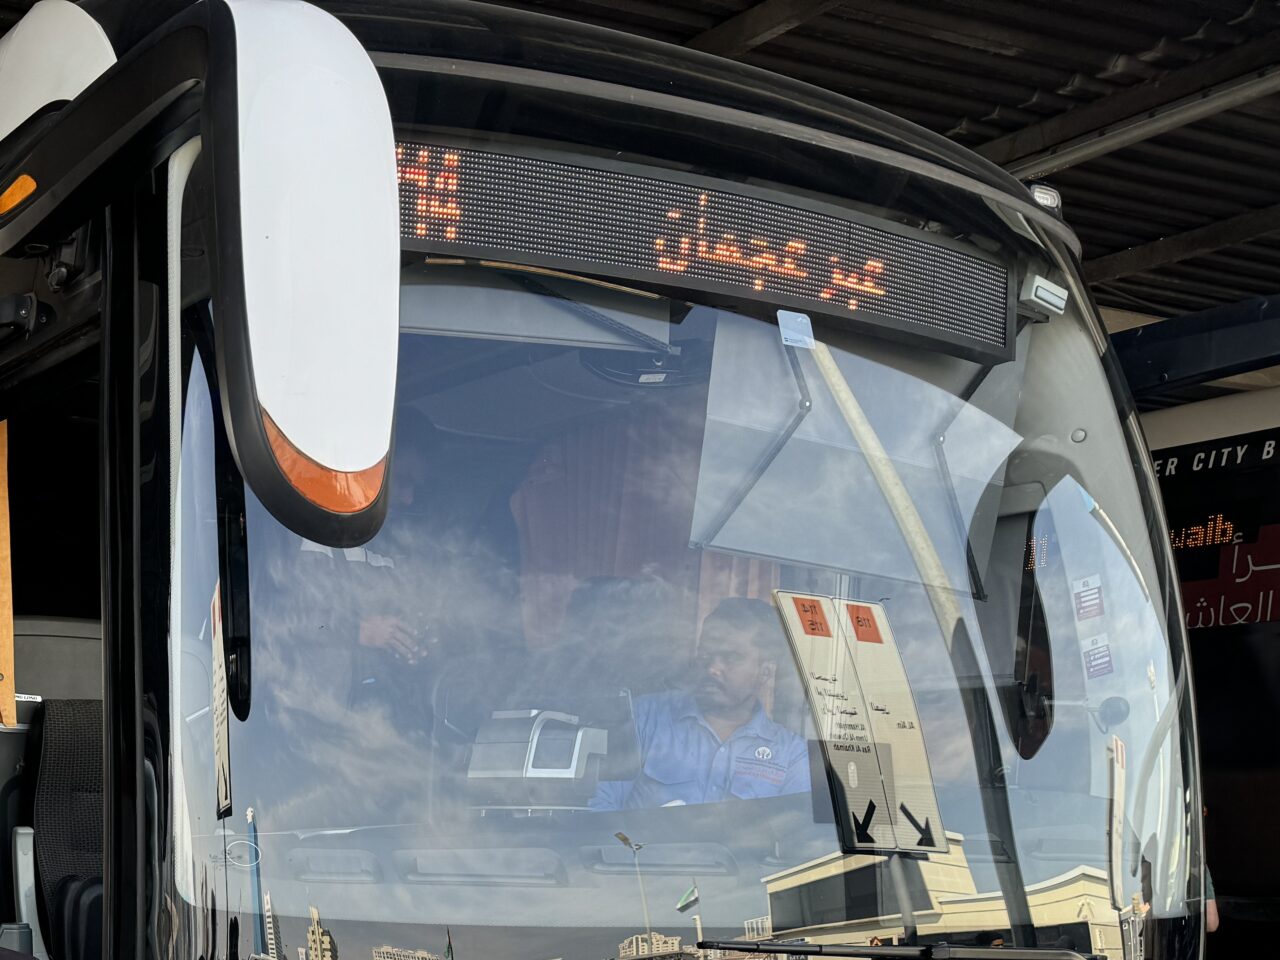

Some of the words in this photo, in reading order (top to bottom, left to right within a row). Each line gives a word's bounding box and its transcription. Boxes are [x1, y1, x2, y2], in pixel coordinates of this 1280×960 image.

[655, 194, 807, 290] عجمان
[820, 256, 886, 310] عبر
[1192, 444, 1249, 471] CITY
[1262, 440, 1276, 460] B
